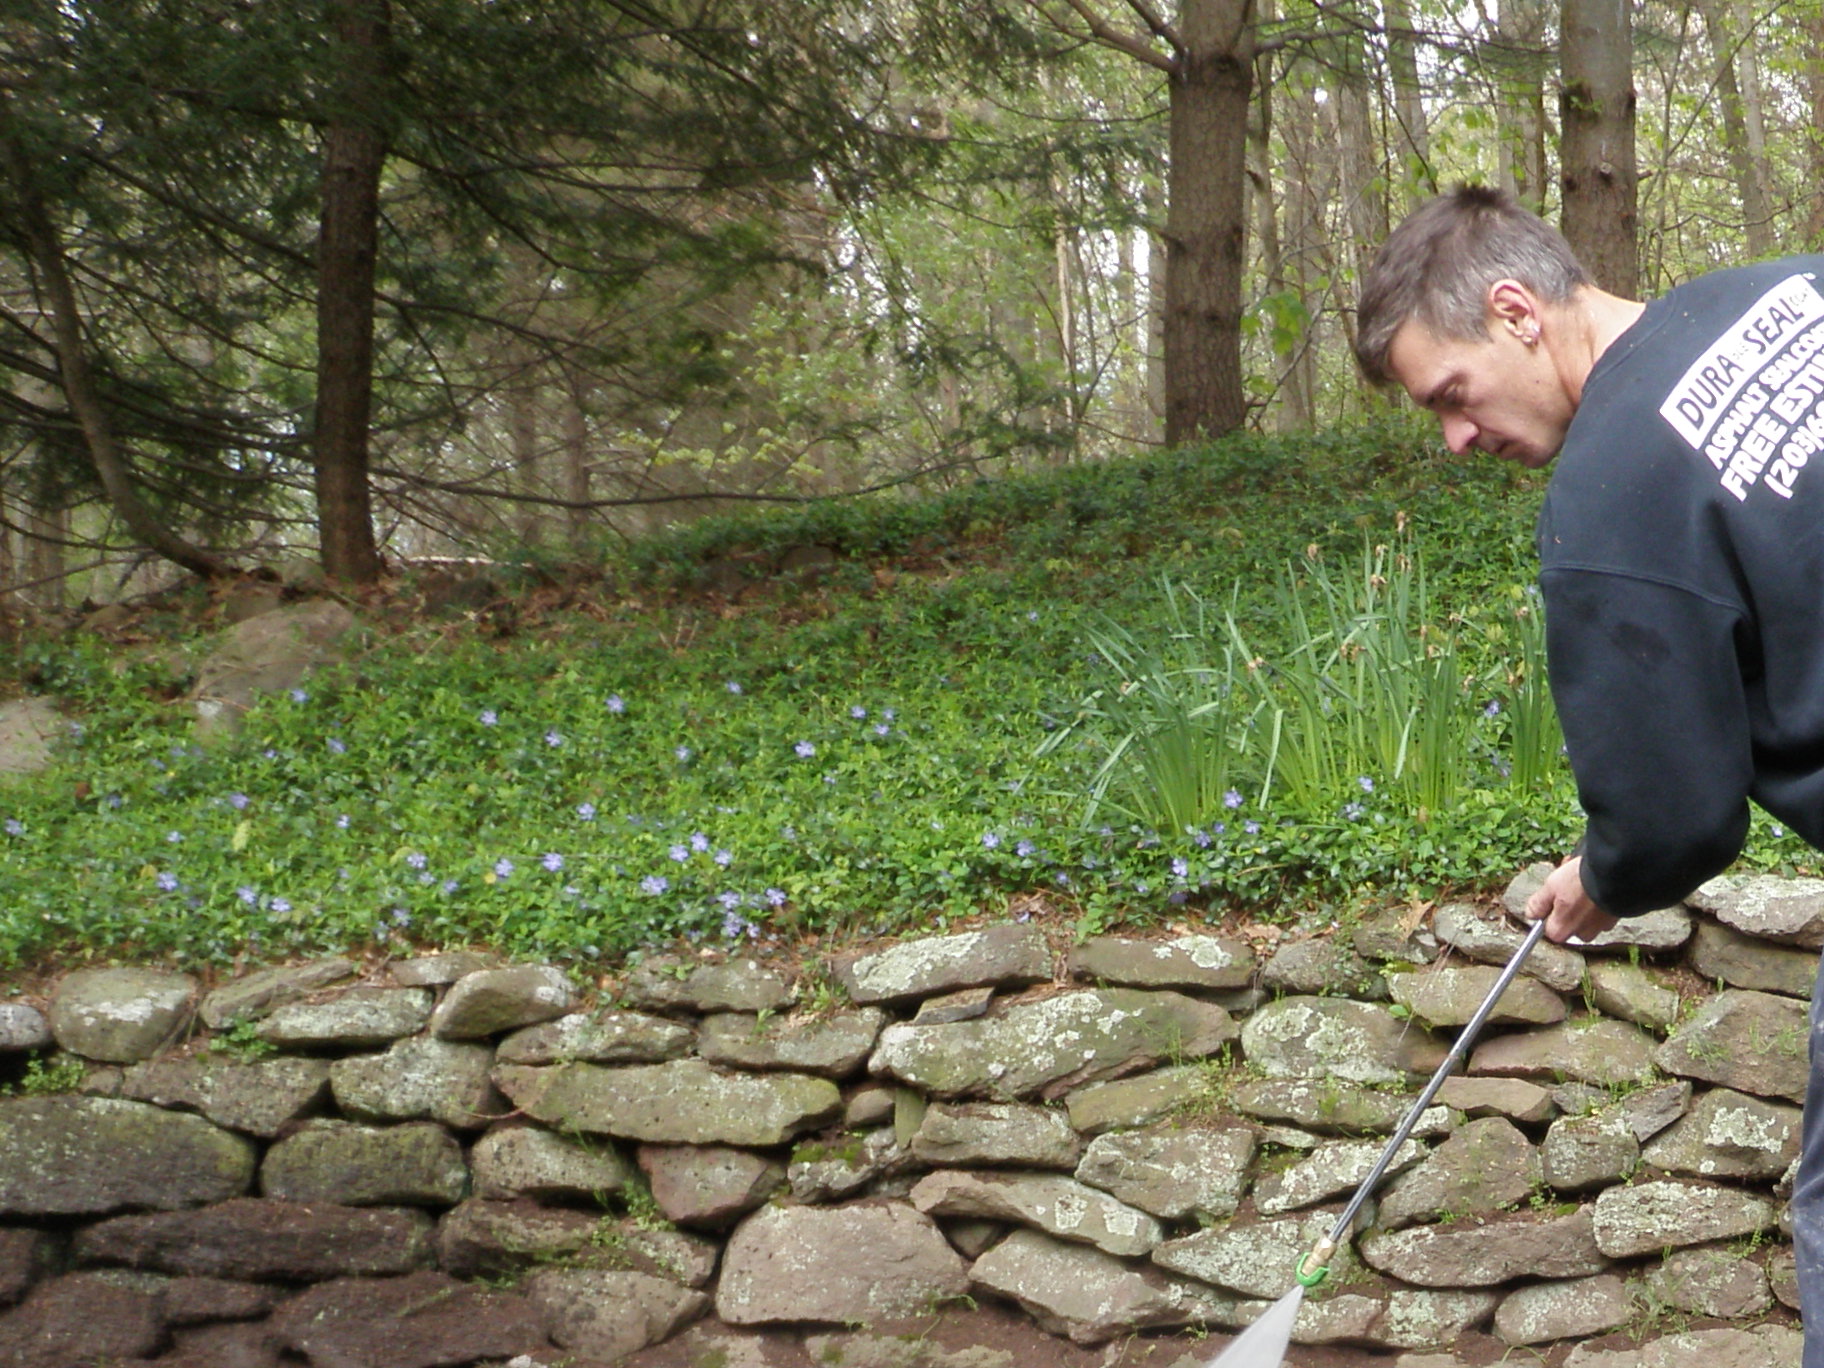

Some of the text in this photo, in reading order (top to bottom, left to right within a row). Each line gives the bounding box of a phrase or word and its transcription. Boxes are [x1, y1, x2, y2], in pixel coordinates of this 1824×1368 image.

[1676, 298, 1805, 431] DURA SEAL
[1720, 413, 1787, 501] FREE
